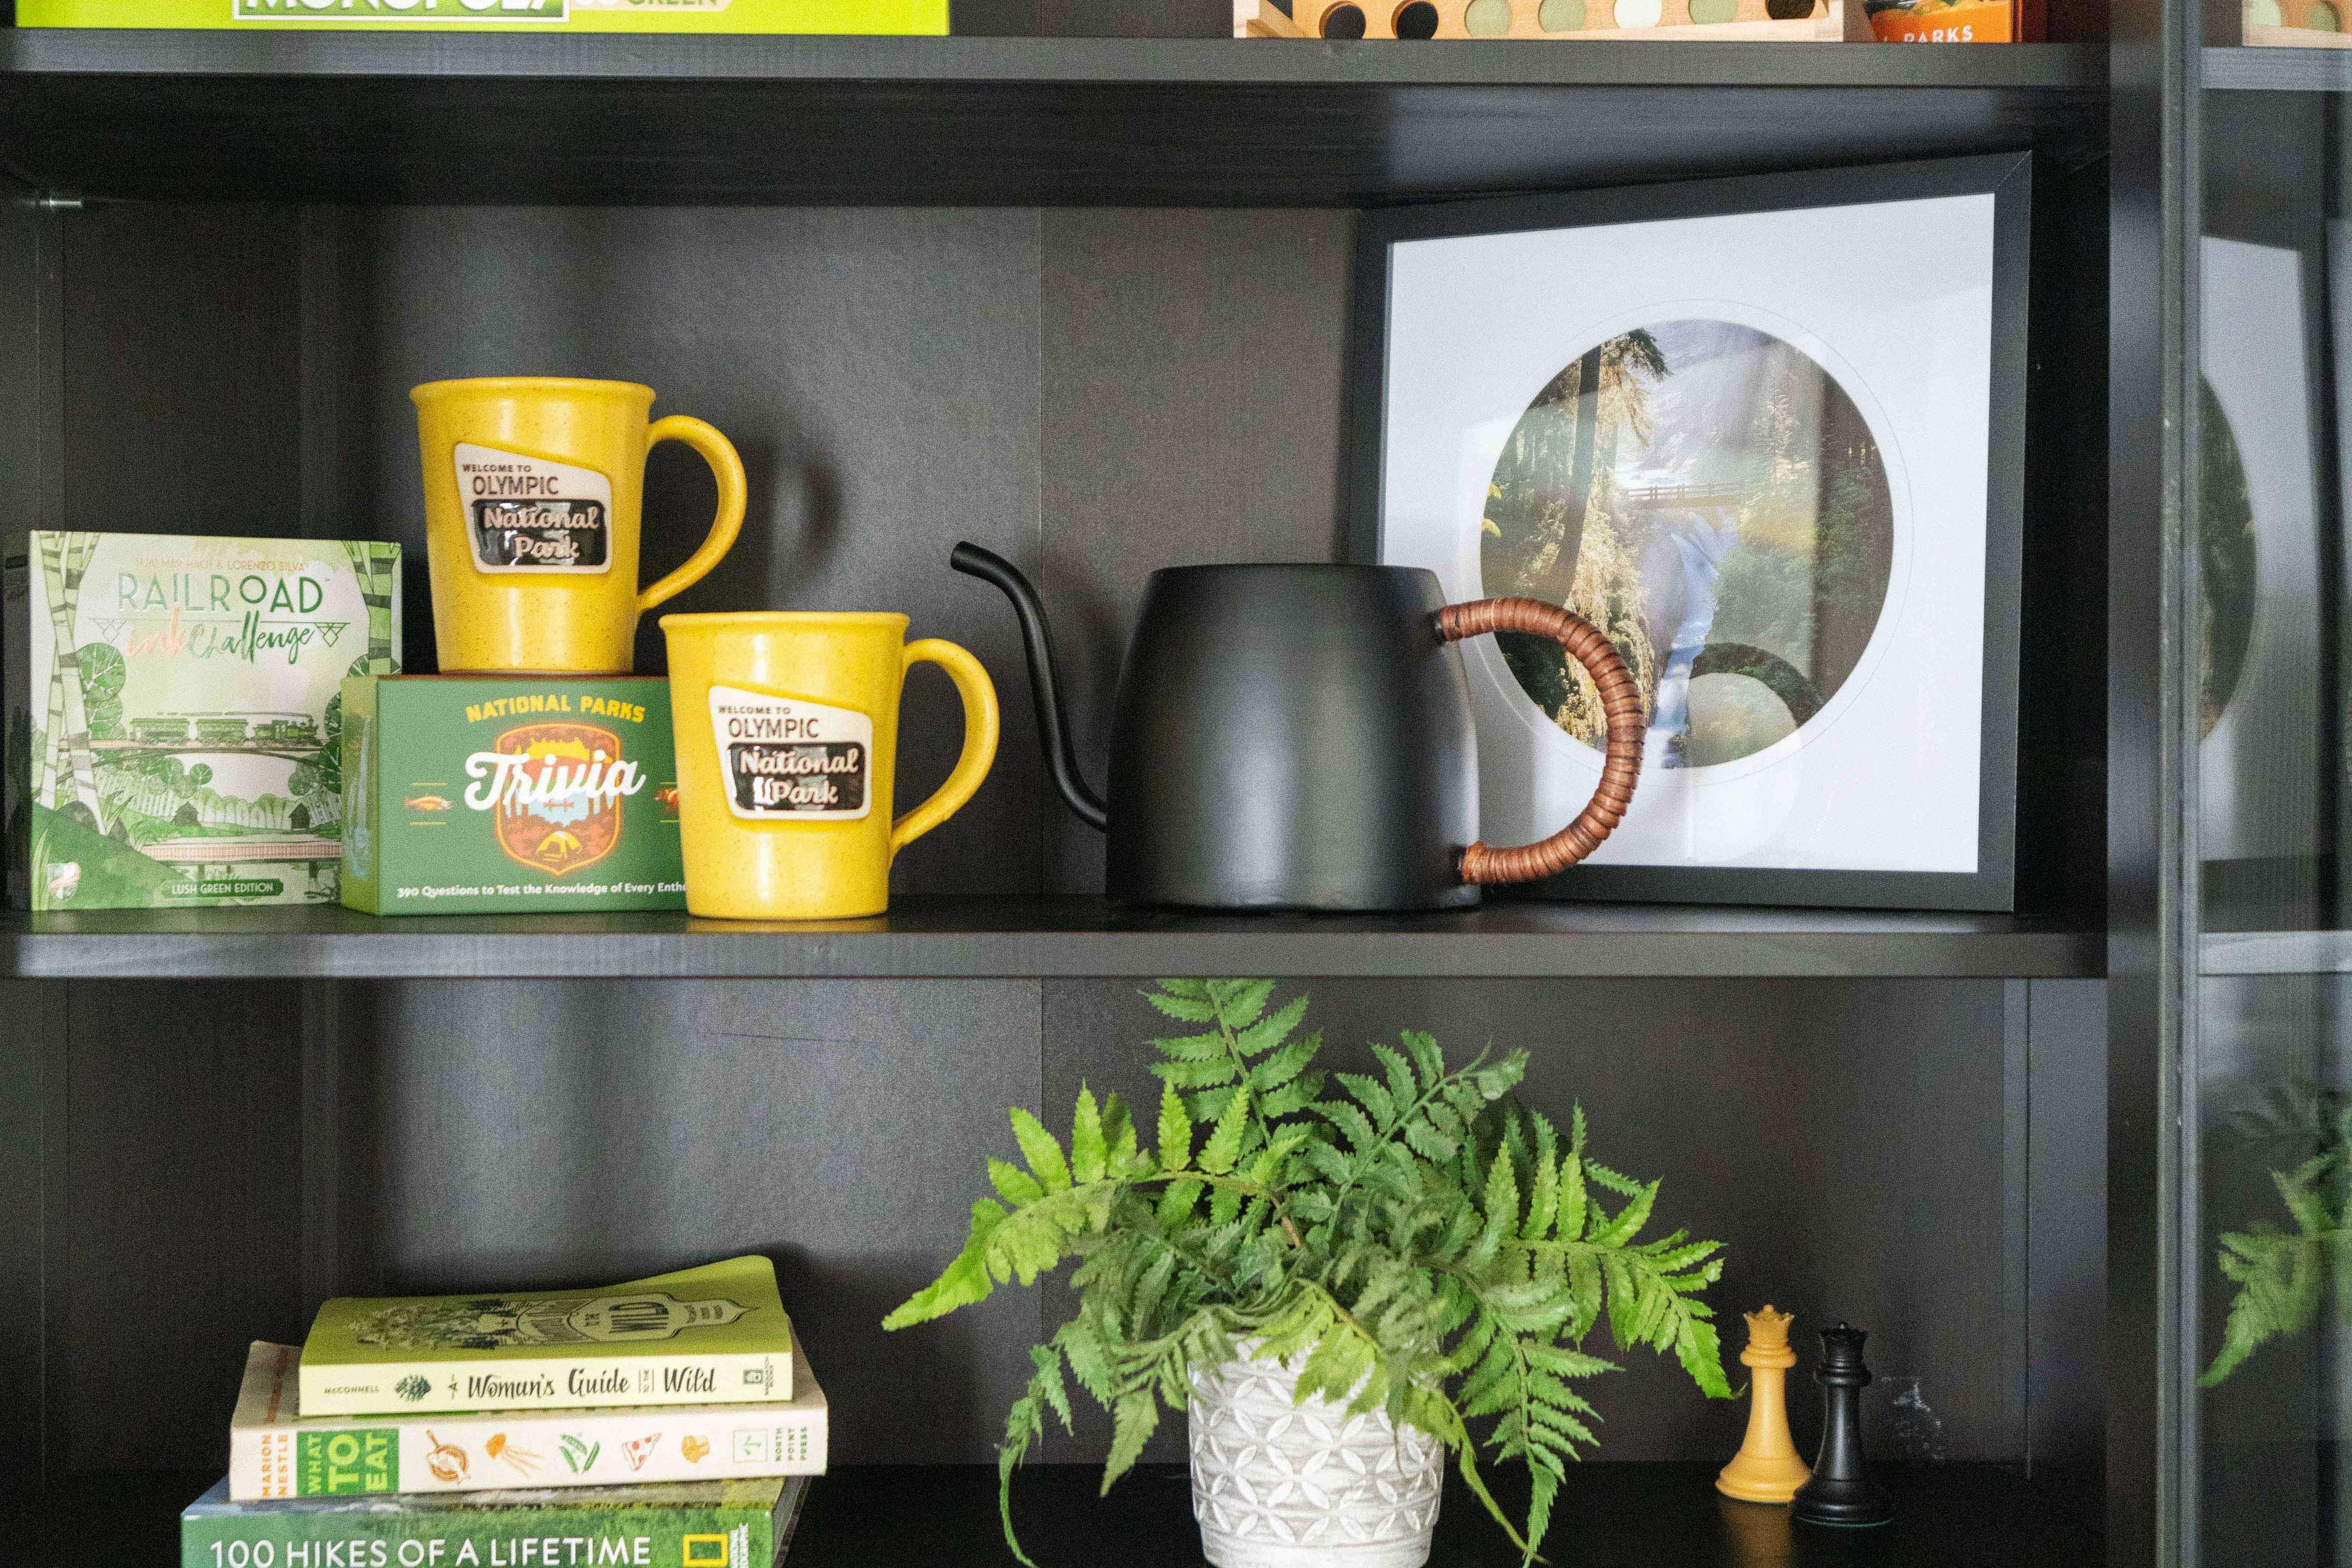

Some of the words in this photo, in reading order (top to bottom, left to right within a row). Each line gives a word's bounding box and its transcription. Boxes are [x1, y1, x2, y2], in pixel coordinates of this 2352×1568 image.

[462, 464, 513, 473] WELCOME
[517, 464, 531, 473] TO
[472, 475, 559, 495] OLYMPIC
[484, 506, 599, 530] National
[513, 534, 580, 559] Park
[227, 559, 275, 571] LORENZO
[280, 561, 305, 571] SILVA
[118, 572, 324, 613] RAILROAD
[186, 609, 315, 664] Challenge
[465, 694, 572, 723] NATIONAL
[579, 696, 646, 723] PARKS
[718, 705, 771, 714] WELCOME
[775, 706, 790, 714] TO
[728, 717, 819, 738] OLYMPIC
[739, 748, 859, 774] National
[464, 749, 647, 811] Trivia
[771, 779, 839, 804] Park
[171, 883, 197, 895] LUSH
[201, 883, 232, 893] GREEN
[234, 881, 273, 893] EDITION
[421, 885, 480, 898] Questions
[482, 885, 494, 895] to
[497, 884, 520, 895] Test
[523, 883, 542, 895] the
[544, 883, 608, 896] Knowledge
[610, 882, 622, 893] of
[625, 882, 655, 894] Every
[468, 1372, 555, 1399] Woman's
[567, 1367, 630, 1397] Guide
[663, 1365, 717, 1394] Wild
[261, 1434, 271, 1497] MARION
[277, 1434, 288, 1497] NESTLE
[308, 1435, 321, 1494] WHAT
[327, 1434, 360, 1493] TO
[365, 1432, 388, 1491] EAT
[210, 1540, 274, 1568] 100
[286, 1540, 388, 1568] HIKES
[397, 1539, 446, 1568] OF
[455, 1538, 479, 1567] A
[491, 1537, 651, 1567] LIFETIME
